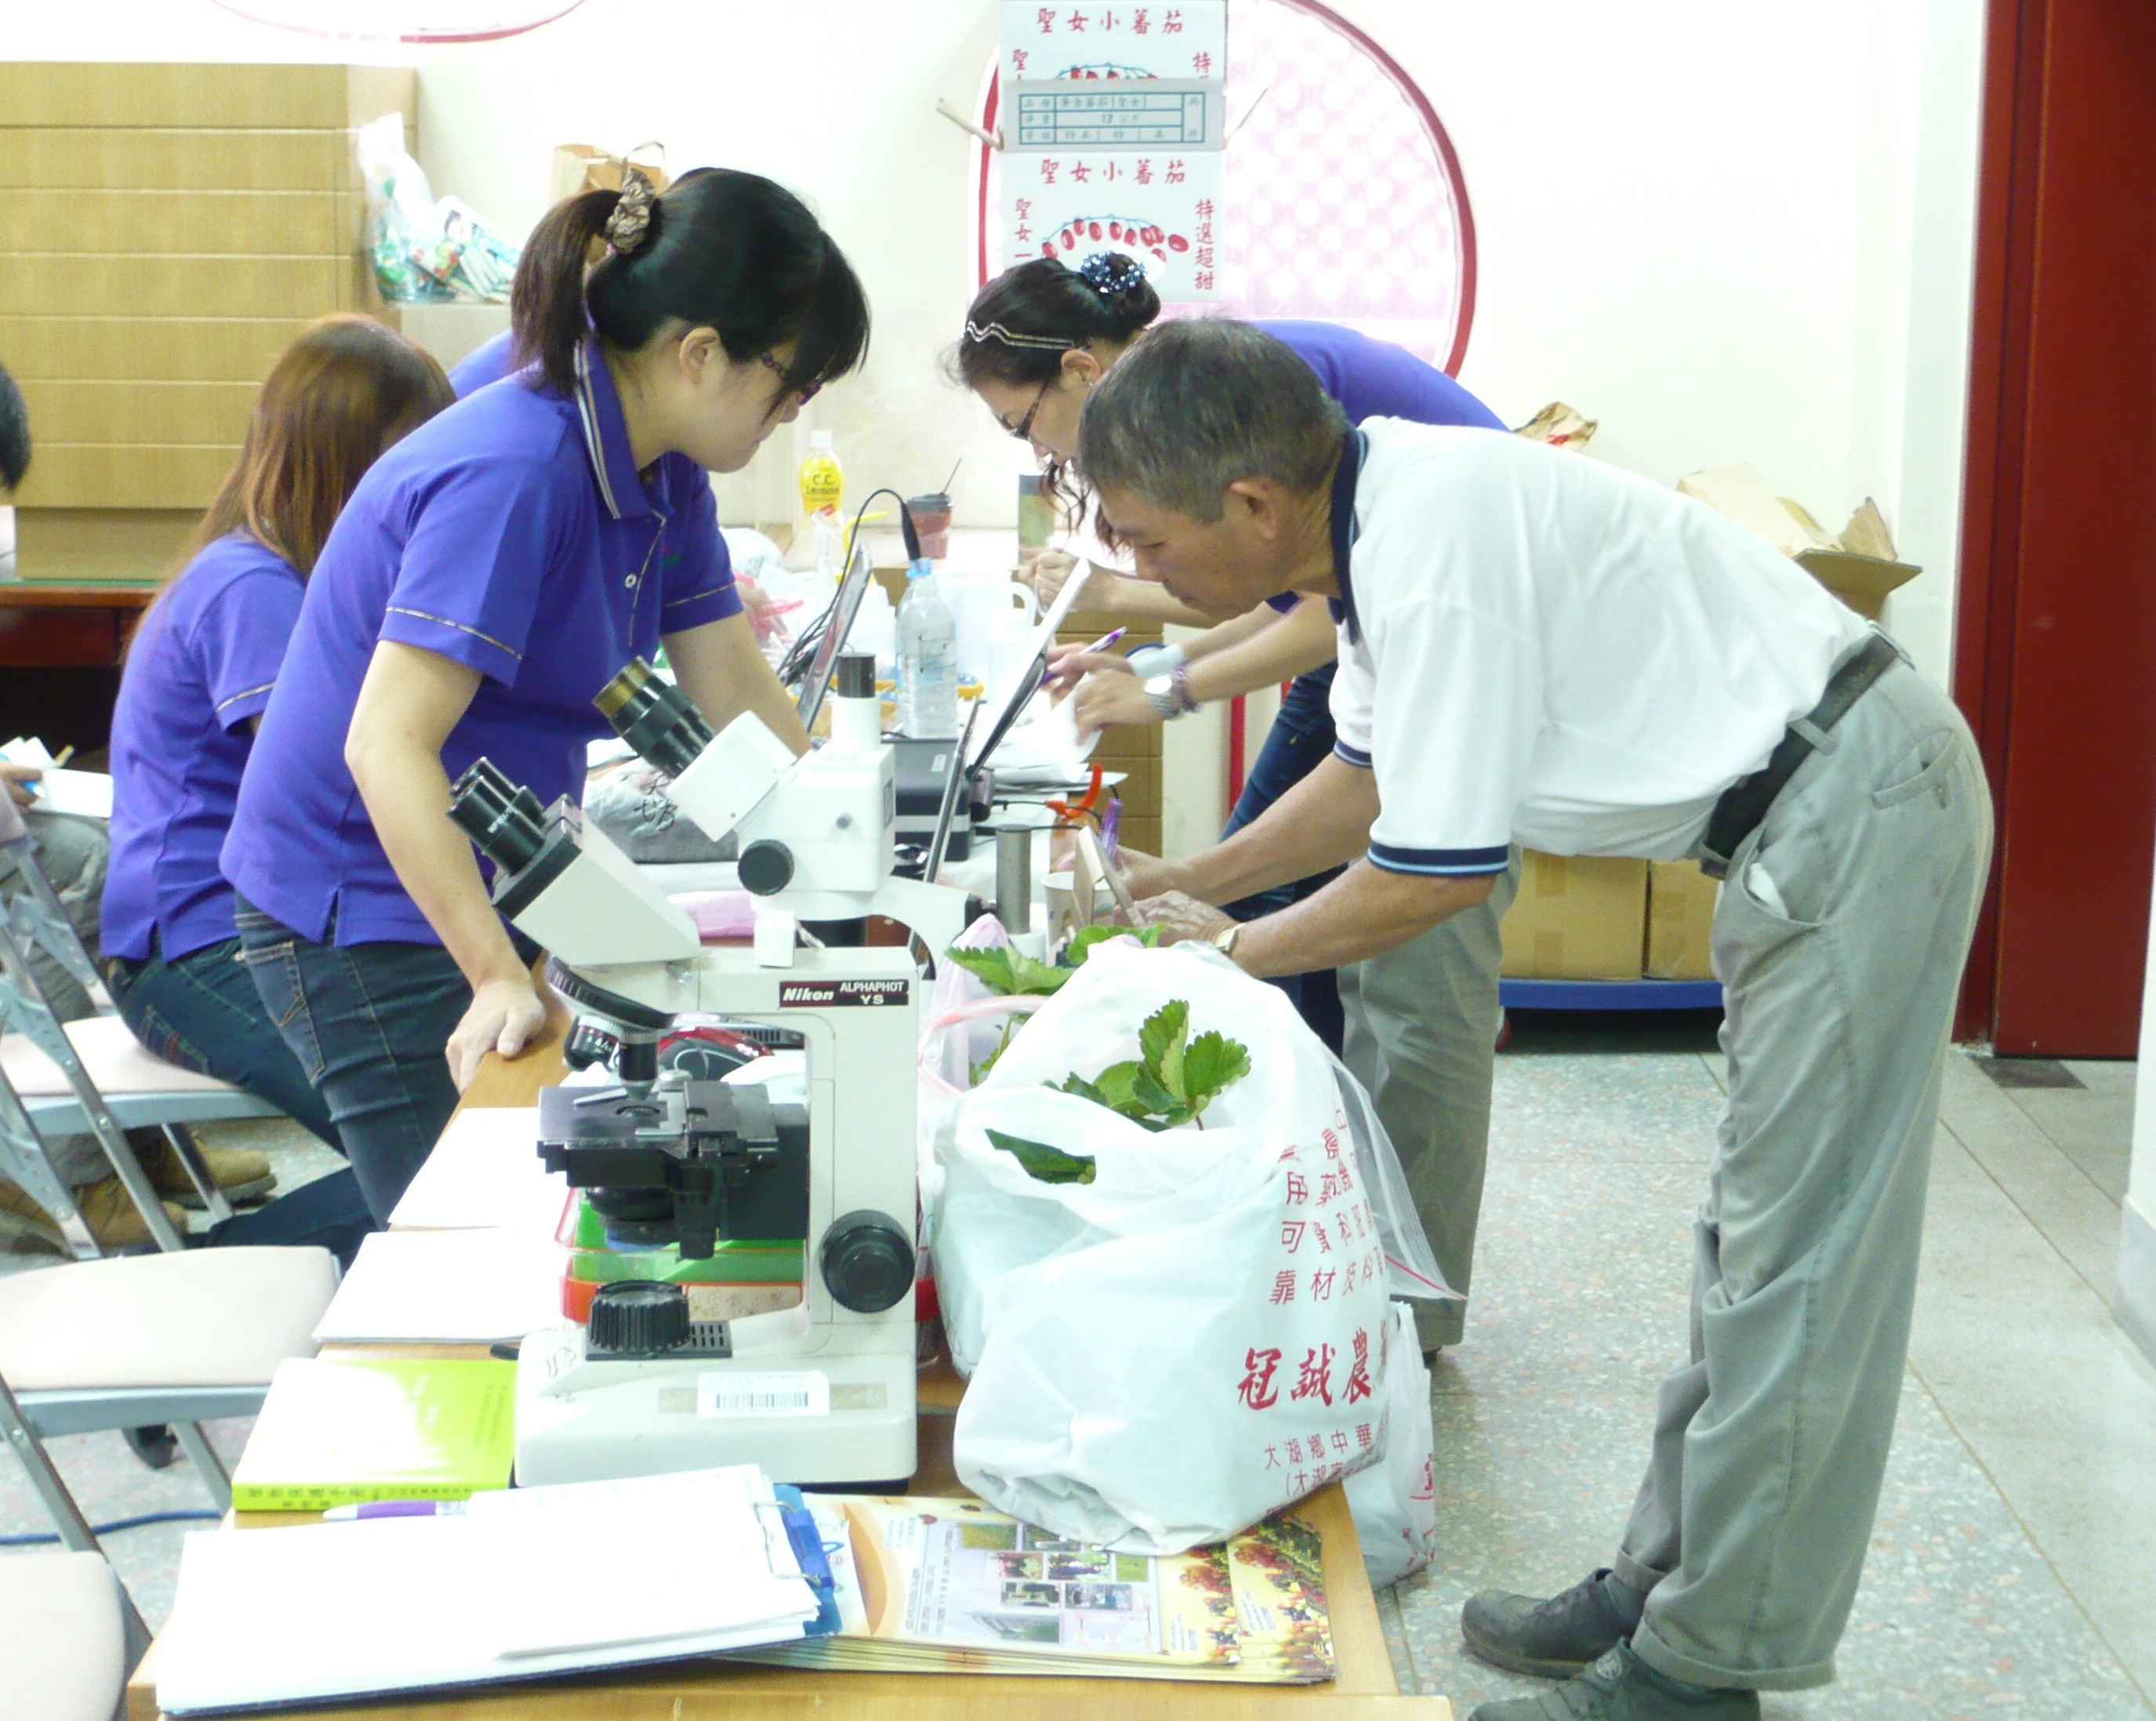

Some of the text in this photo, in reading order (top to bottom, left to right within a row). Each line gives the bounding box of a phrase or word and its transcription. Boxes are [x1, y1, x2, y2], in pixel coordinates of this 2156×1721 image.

[1037, 8, 1183, 34] 聖女小蕃茄
[1012, 49, 1029, 80] 聖
[1192, 52, 1211, 79] 特
[1040, 159, 1186, 185] 聖女小蕃茄
[1194, 199, 1214, 290] 特選超甜
[782, 981, 905, 1002] Nikon ALPHAPHOT
[860, 994, 884, 1005] YS
[1237, 1319, 1387, 1411] 冠誠農
